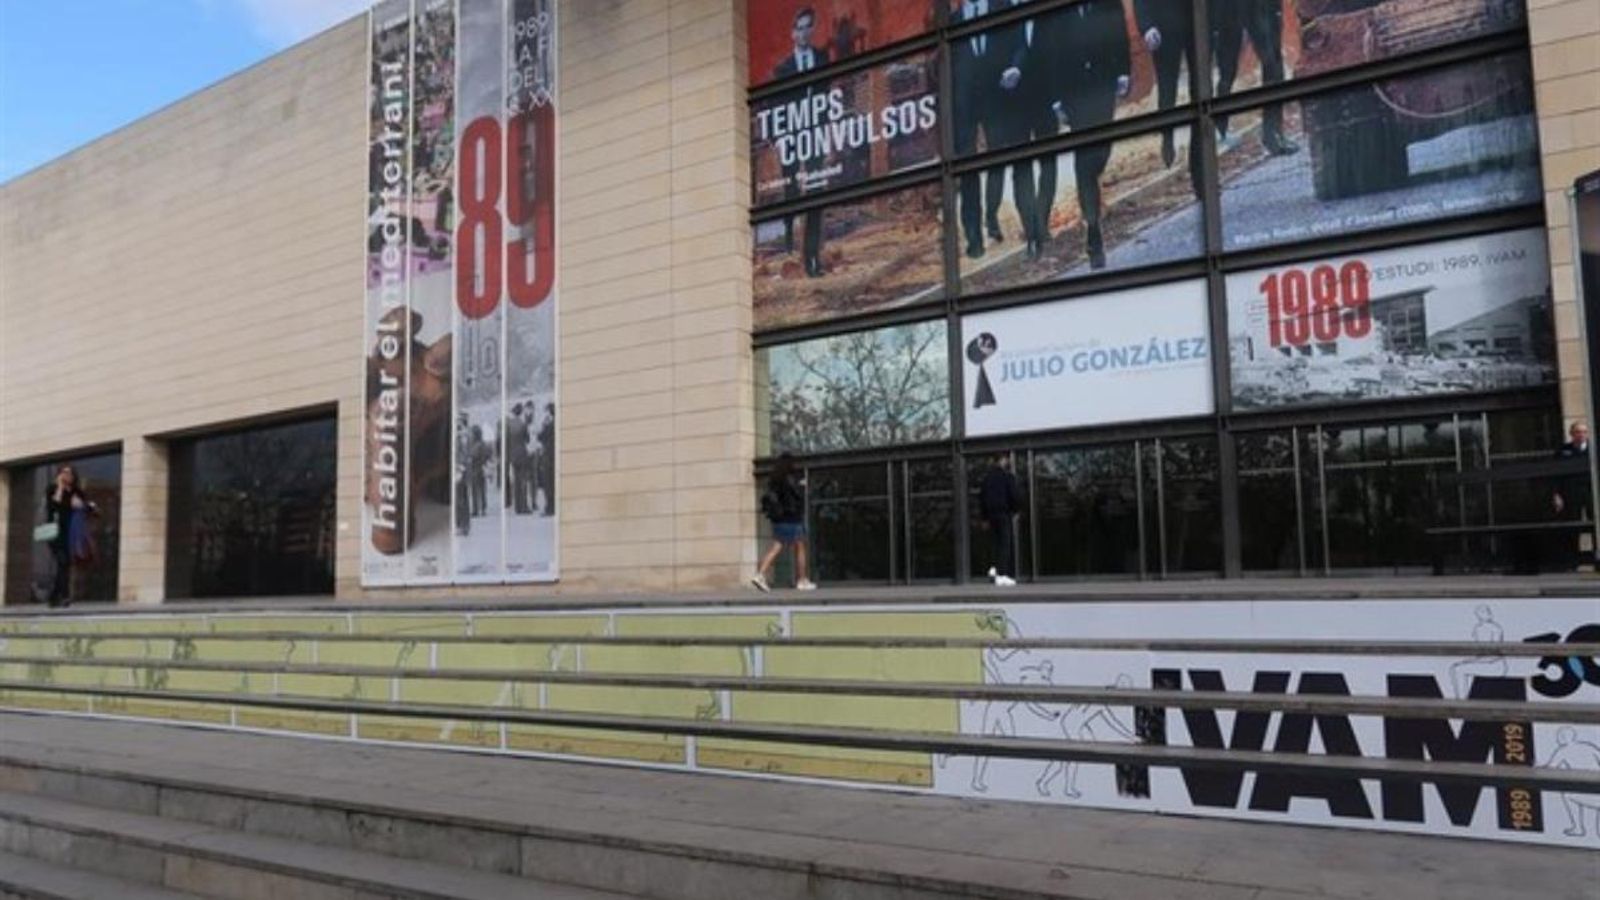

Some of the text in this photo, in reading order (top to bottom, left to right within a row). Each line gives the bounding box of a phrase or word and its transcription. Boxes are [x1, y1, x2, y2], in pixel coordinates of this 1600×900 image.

[757, 88, 844, 139] TEMPS
[776, 95, 937, 166] CONVULSOS
[456, 99, 556, 319] 89
[376, 319, 399, 359] el
[1260, 260, 1373, 348] 1989
[1001, 354, 1065, 383] JULIO
[1071, 337, 1207, 373] GONZÁLEZ
[372, 369, 399, 529] habitar
[1115, 668, 1544, 832] IVAM
[1503, 723, 1533, 830] 1989 2019
